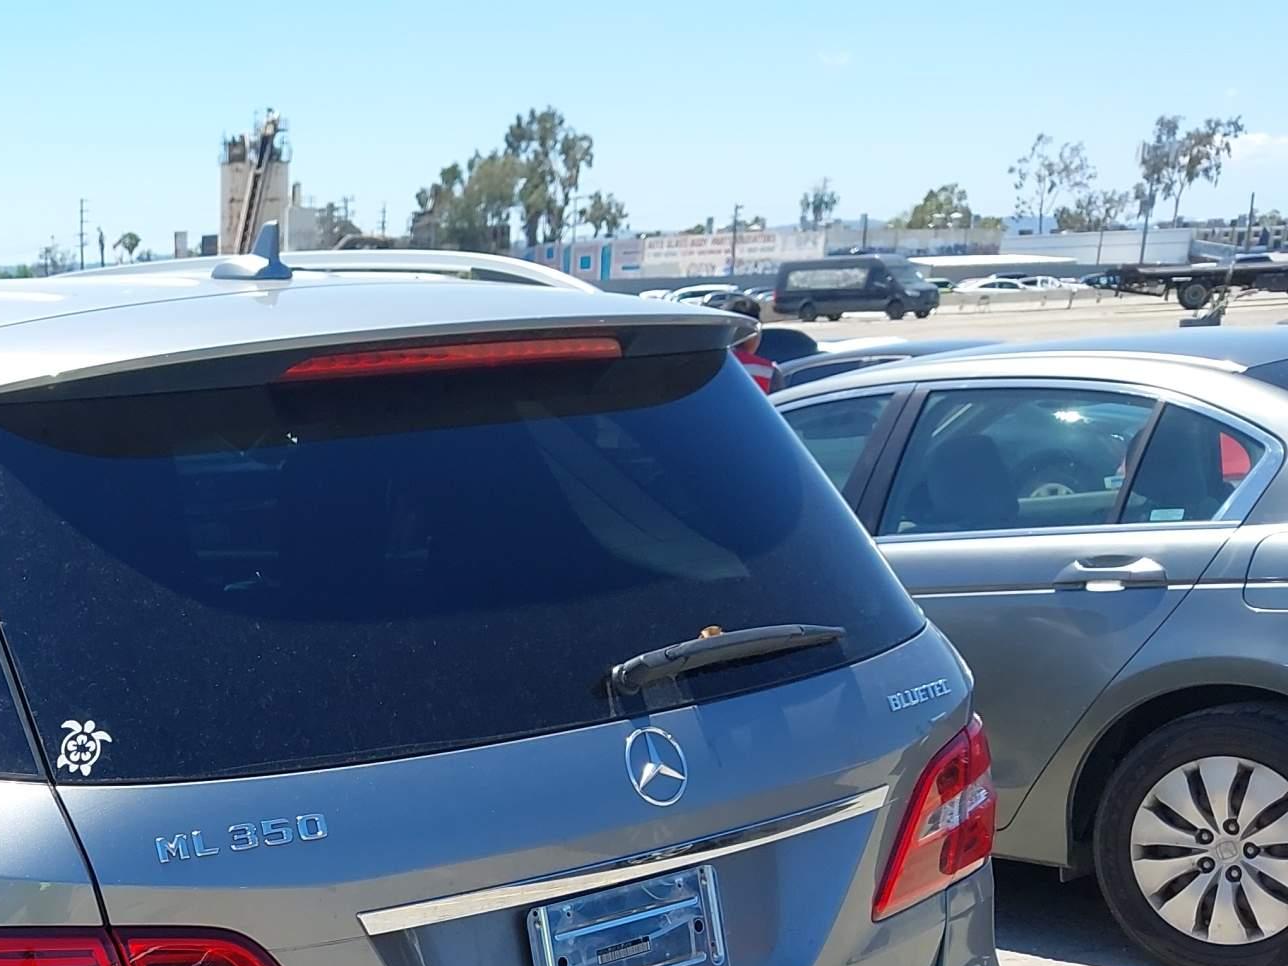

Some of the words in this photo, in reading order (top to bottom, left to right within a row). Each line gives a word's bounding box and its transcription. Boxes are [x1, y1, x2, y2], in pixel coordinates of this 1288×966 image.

[887, 679, 952, 711] BLUETEC
[155, 830, 219, 863] ML
[228, 813, 328, 850] 350
